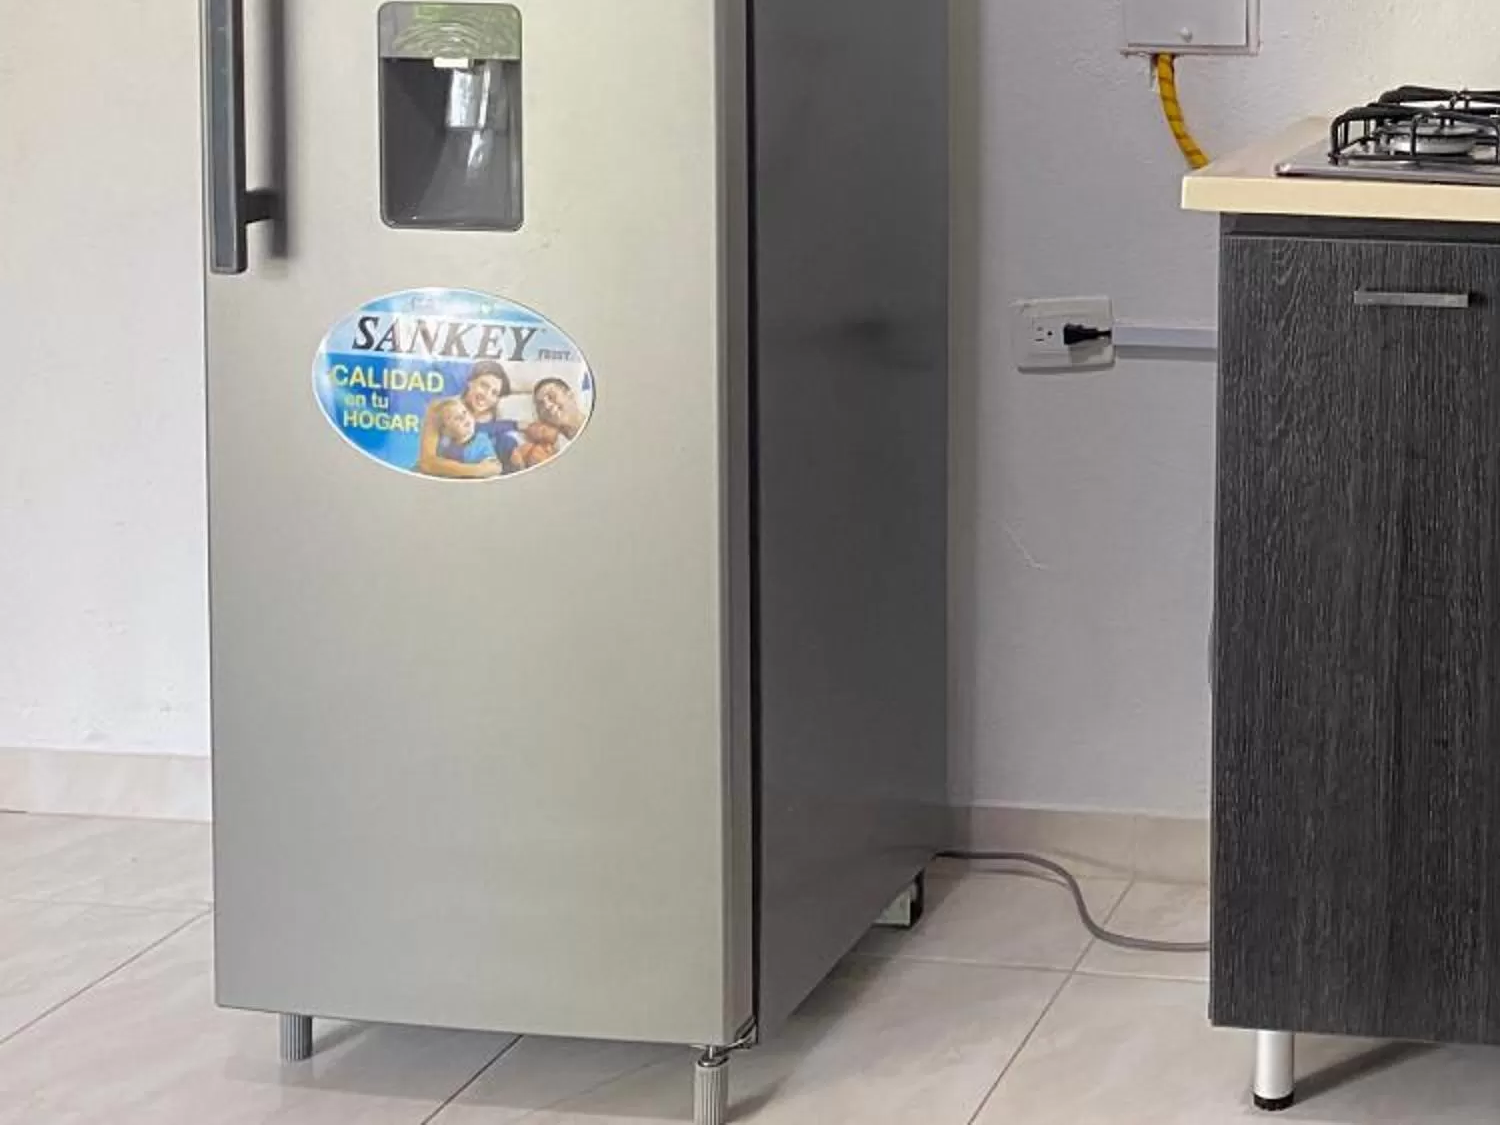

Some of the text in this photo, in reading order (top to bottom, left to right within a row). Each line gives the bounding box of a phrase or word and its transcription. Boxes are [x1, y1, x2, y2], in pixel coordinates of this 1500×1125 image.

[352, 316, 537, 362] SANKEY
[330, 364, 444, 393] CALIDAD
[345, 390, 389, 410] en tu
[343, 410, 420, 432] HOGAR
